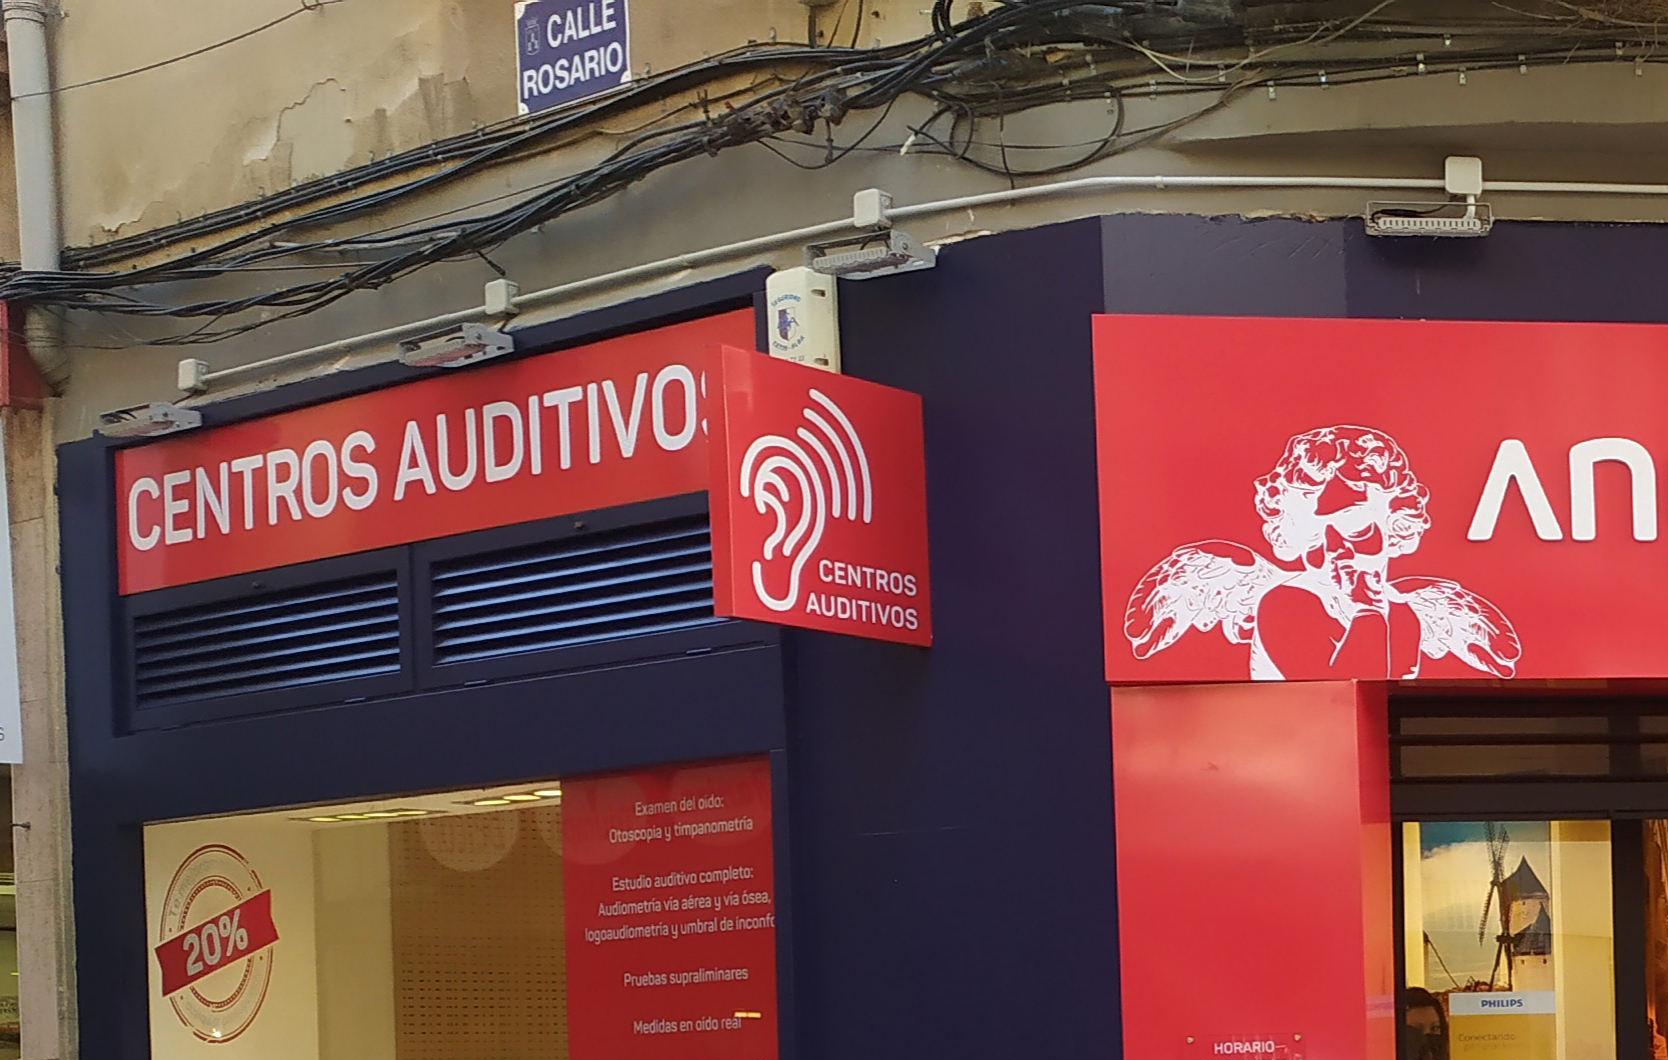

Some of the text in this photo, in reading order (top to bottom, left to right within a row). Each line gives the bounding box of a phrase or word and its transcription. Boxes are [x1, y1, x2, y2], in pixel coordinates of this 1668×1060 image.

[547, 0, 616, 48] CALLE
[523, 42, 622, 99] ROSARIO
[128, 364, 708, 551] CENTROS AUDITIVO
[818, 558, 918, 597] CENTROS
[805, 592, 919, 630] AUDITIVOS
[635, 794, 725, 816] Examen del oído:
[609, 816, 754, 844] Otoscopia y timpanometría
[612, 865, 755, 892] Estudio auditivo completo:
[598, 889, 771, 917] Audiometría vía aérea y vía ósea,
[182, 908, 249, 977] 20%
[585, 922, 669, 945] logoaudiometría
[671, 924, 678, 939] y
[680, 917, 718, 935] umbral
[720, 917, 734, 931] de
[624, 967, 749, 987] Pruebas supraliminares
[1481, 998, 1524, 1008] PHILIPS
[633, 1016, 742, 1034] Medidas en oído real
[1213, 1040, 1276, 1055] HORARIO
